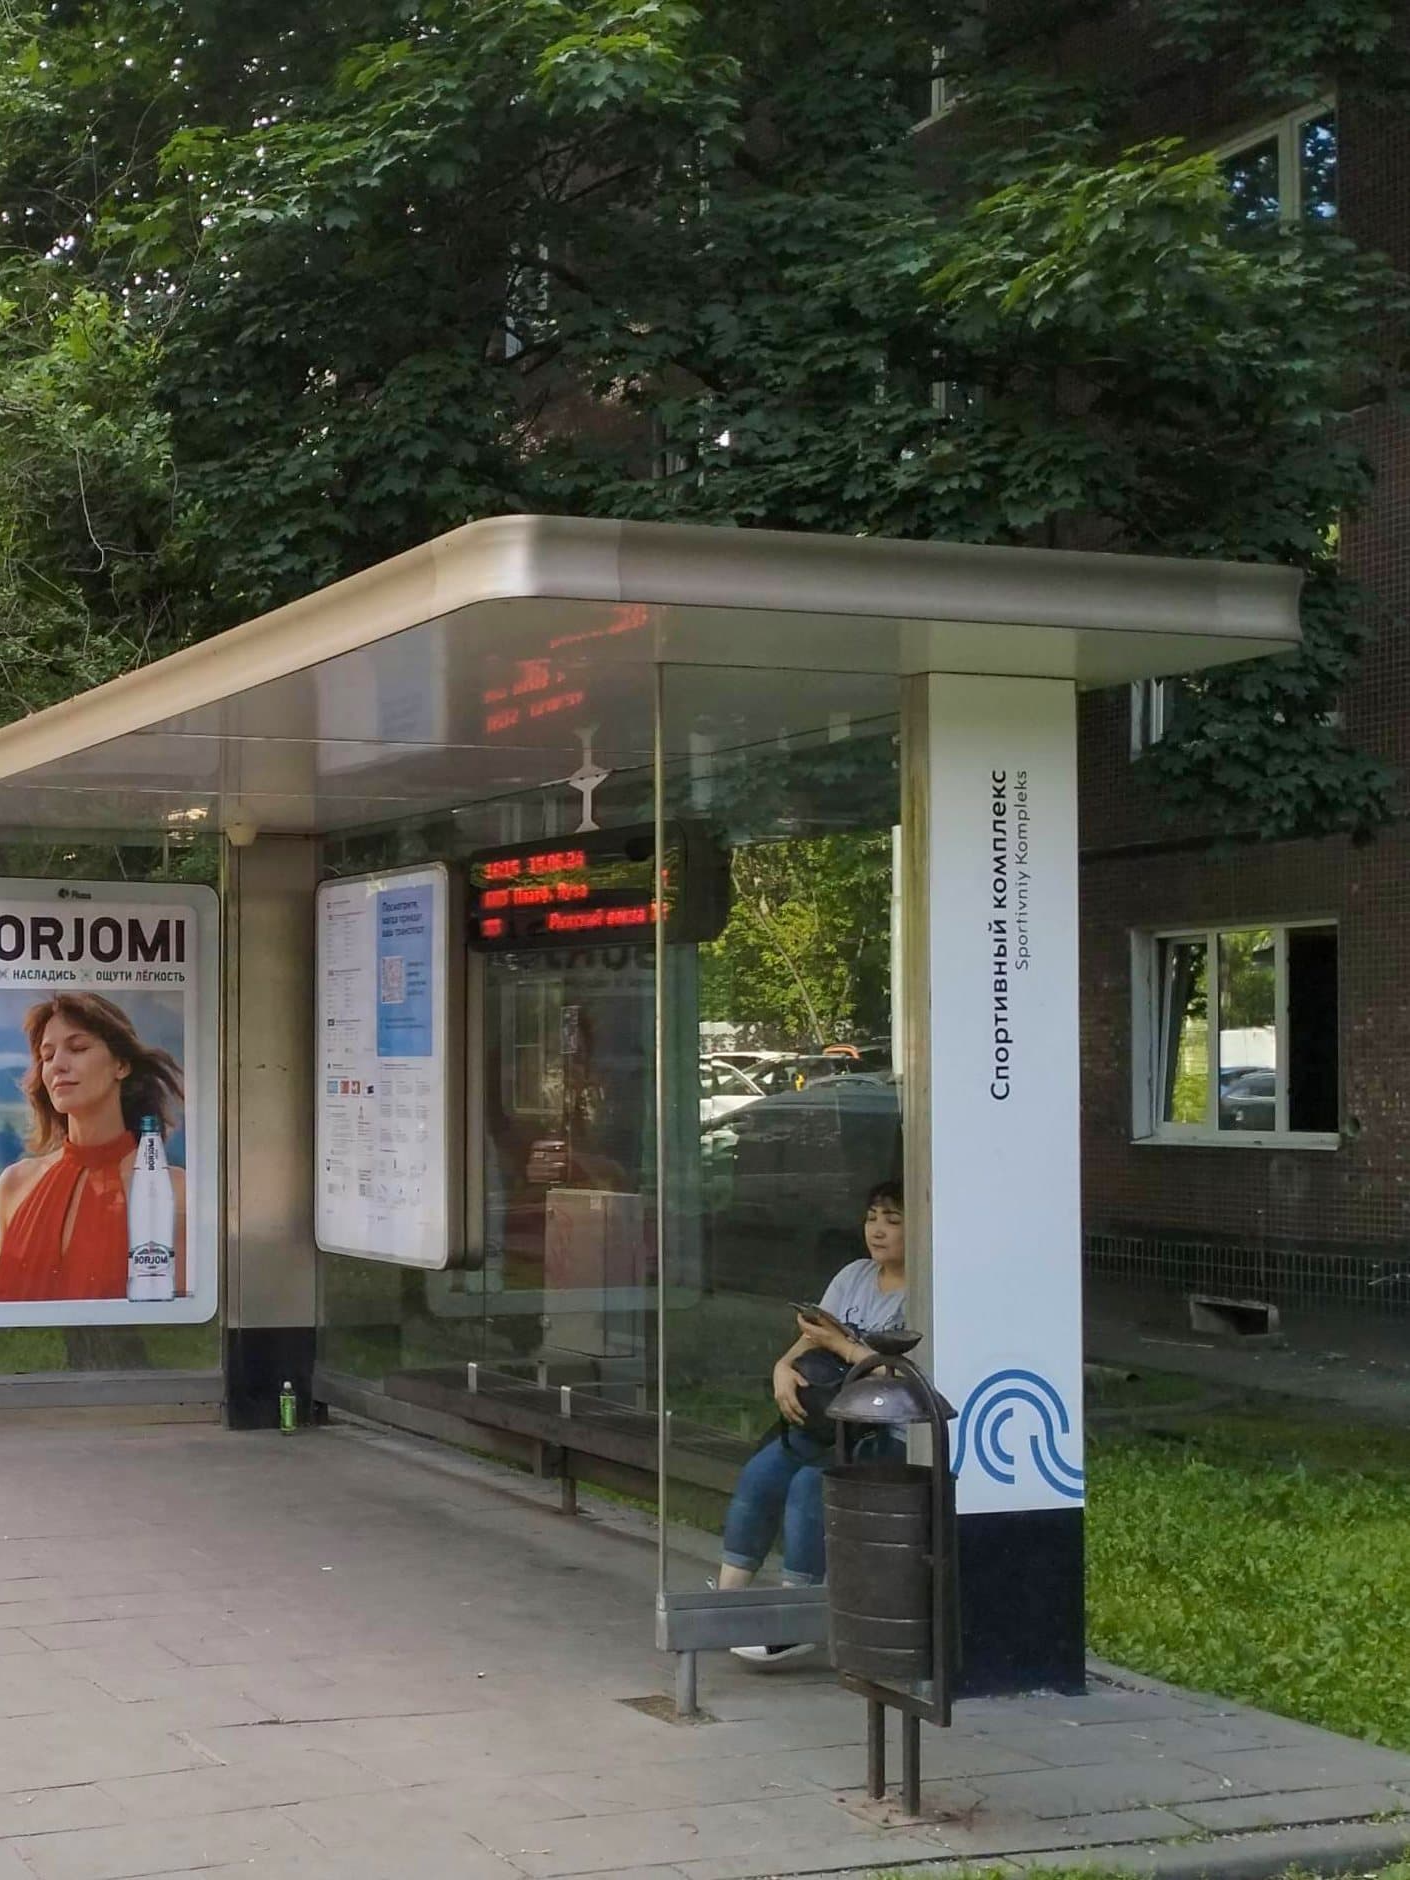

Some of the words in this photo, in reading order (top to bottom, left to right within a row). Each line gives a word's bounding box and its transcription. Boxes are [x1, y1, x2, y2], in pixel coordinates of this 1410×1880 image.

[992, 769, 1008, 909] комплекс
[1014, 769, 1032, 865] Kompleks
[1015, 870, 1032, 970] Sportivniy
[13, 969, 76, 982] НАСЛАДИСЬ
[96, 970, 132, 983] ОЩУТИ
[987, 919, 1014, 1101] Спортивный
